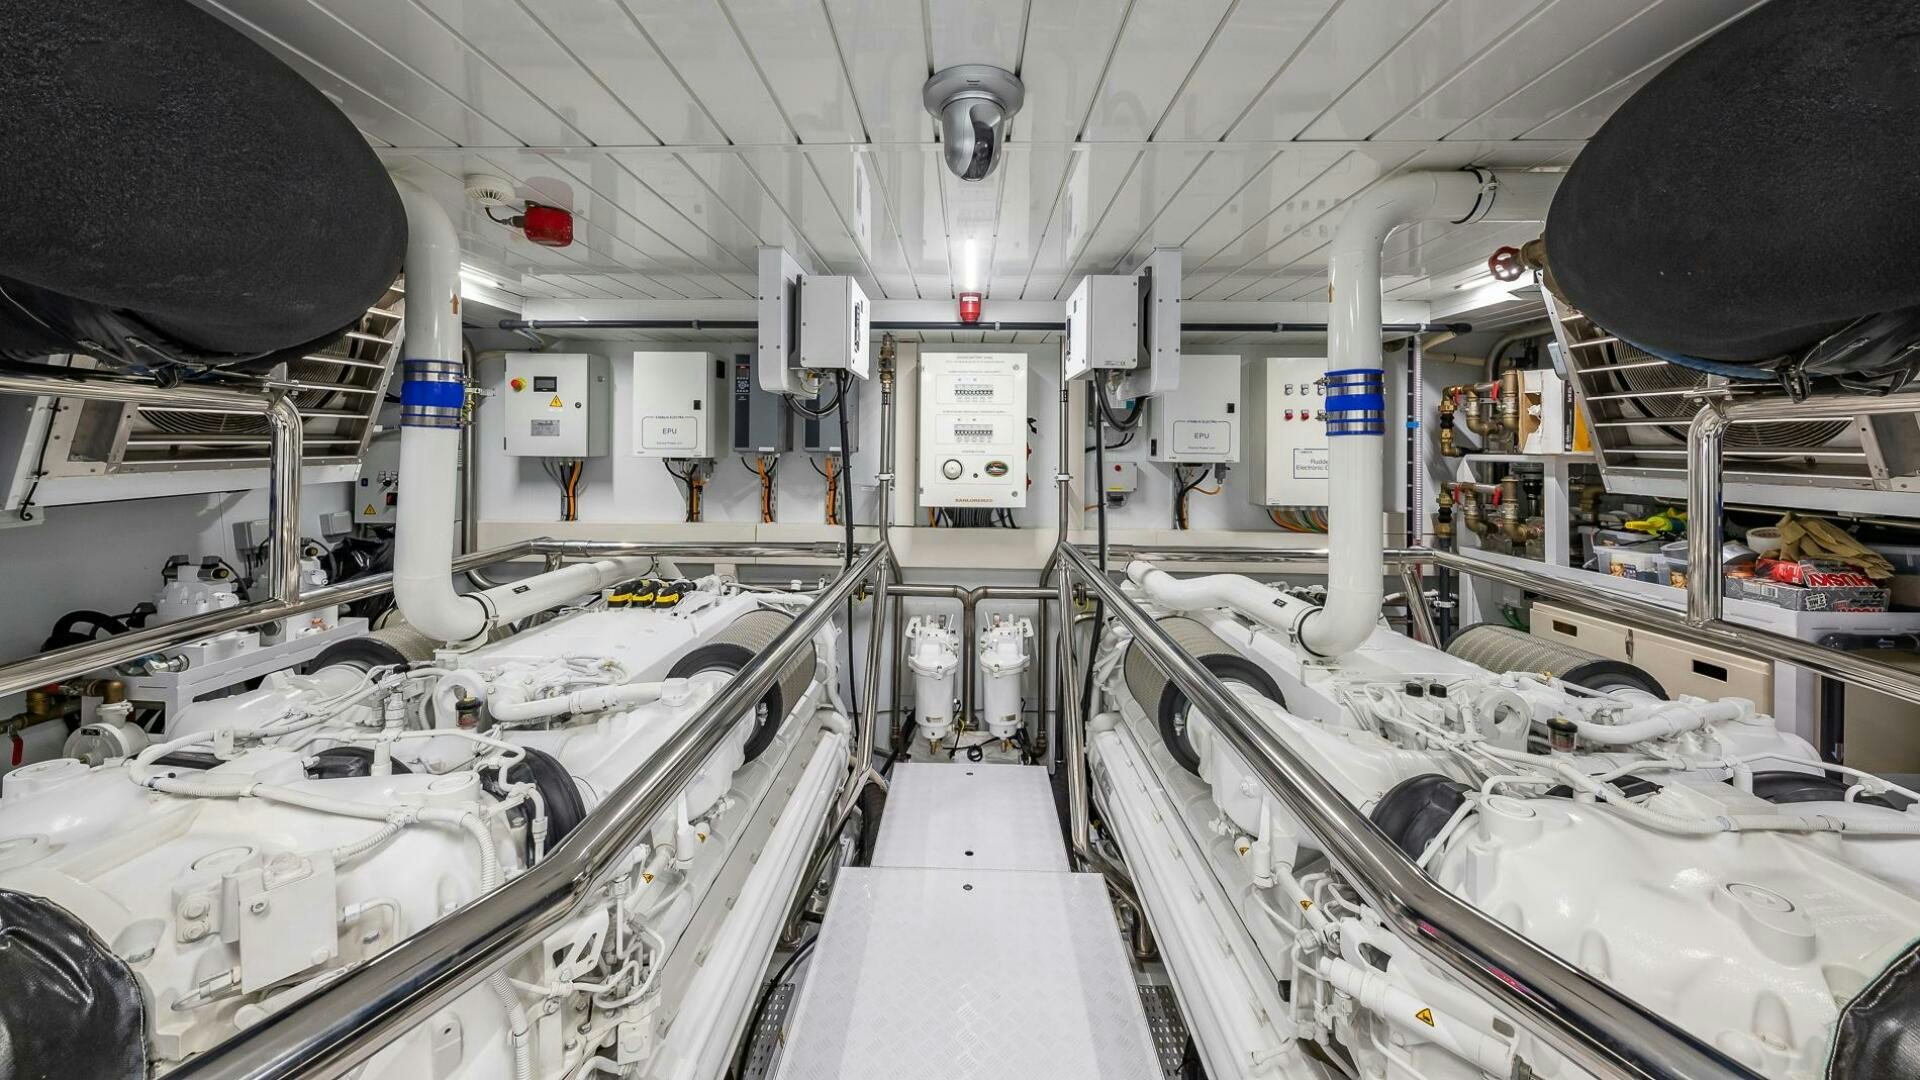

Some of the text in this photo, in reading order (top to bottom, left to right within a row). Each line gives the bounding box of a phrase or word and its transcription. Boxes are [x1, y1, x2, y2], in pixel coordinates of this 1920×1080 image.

[662, 427, 677, 435] EPU
[1193, 432, 1210, 440] EPU
[1807, 572, 1875, 588] HUSKY
